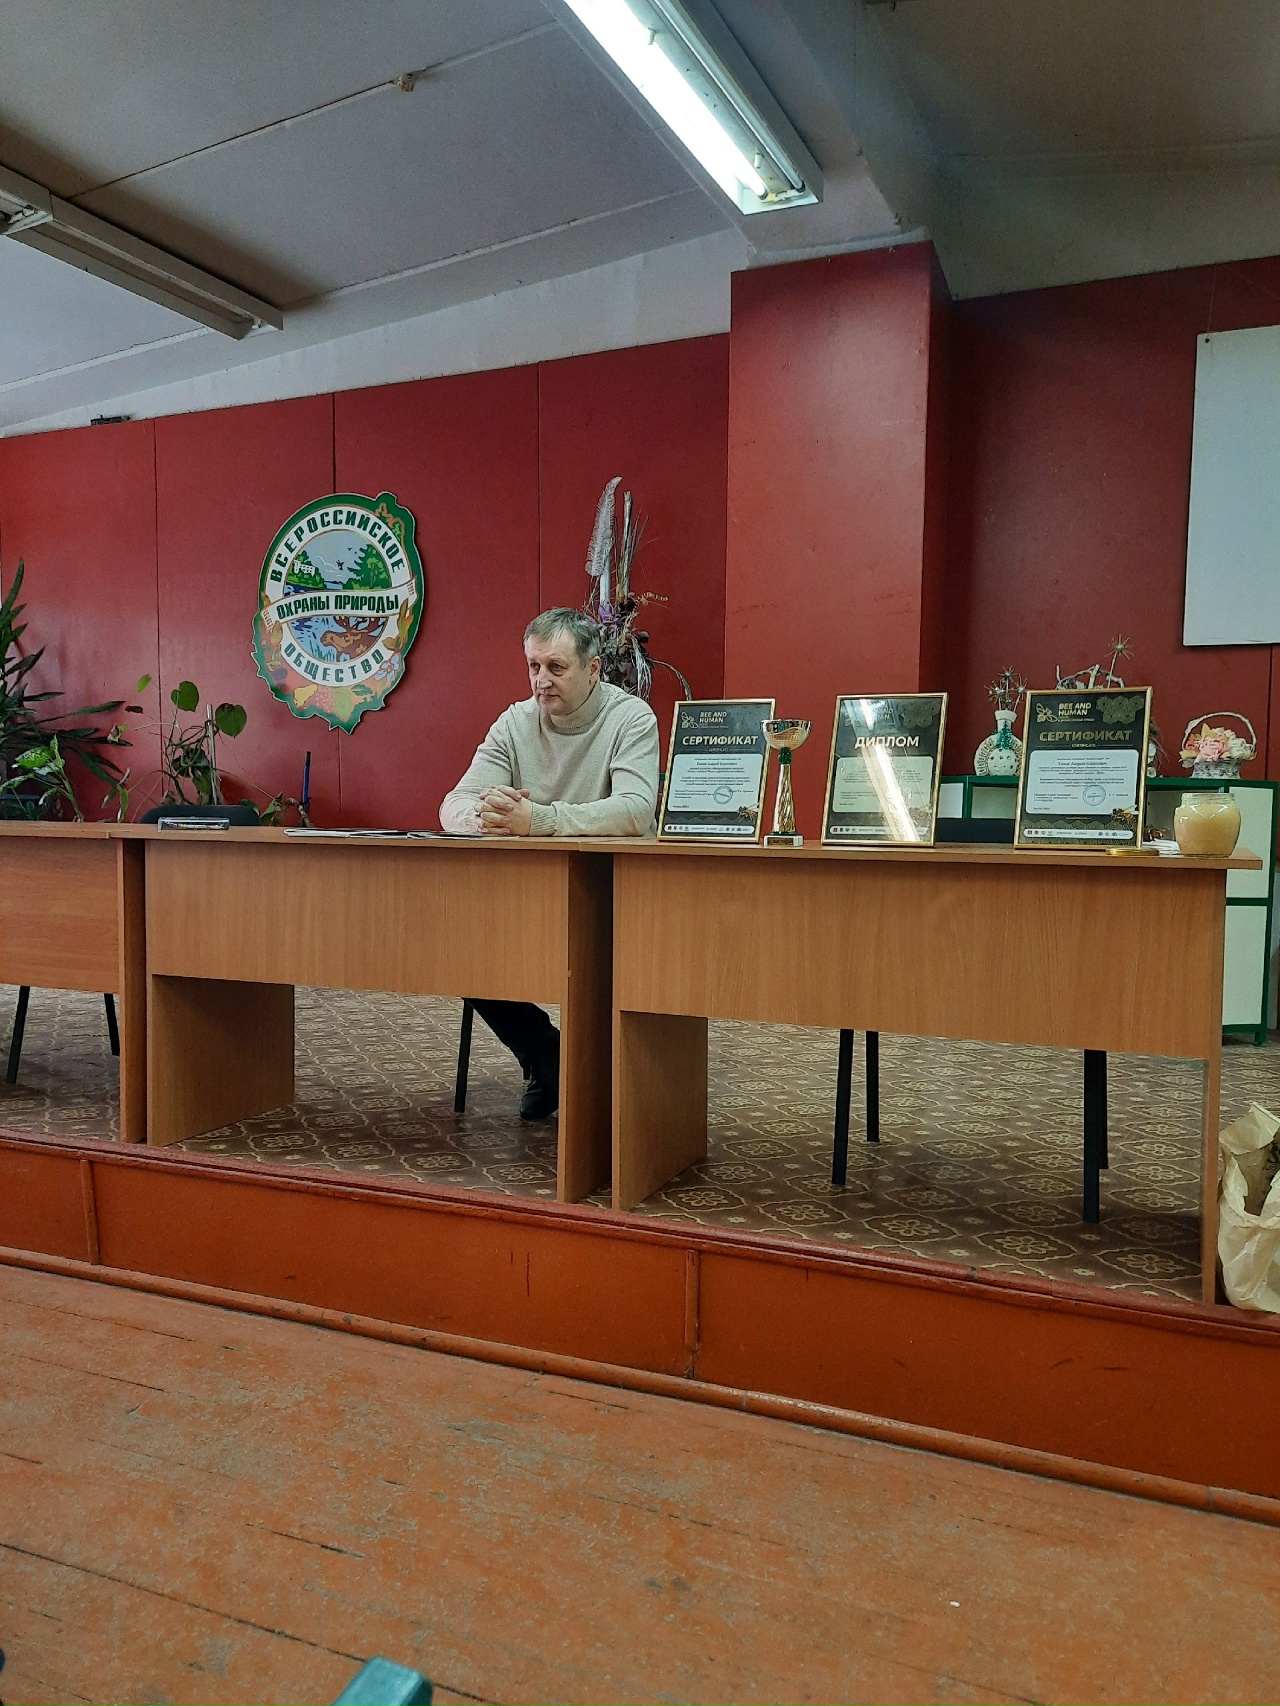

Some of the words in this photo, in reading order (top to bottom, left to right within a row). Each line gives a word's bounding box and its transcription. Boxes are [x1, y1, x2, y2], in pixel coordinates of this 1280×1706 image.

[270, 509, 405, 583] ВСЕРОССИЙСКОЕ
[276, 595, 330, 620] ОХРАНЫ
[334, 594, 399, 613] ПРИРОДЫ
[284, 643, 384, 683] ОБЩЕСТВО
[1058, 702, 1074, 710] BEE
[1074, 702, 1092, 710] AND
[682, 736, 758, 746] СЕРТИФИКАТ
[854, 735, 920, 750] ДИПЛОМ
[1039, 730, 1133, 742] СЕРТИФИКАТ
